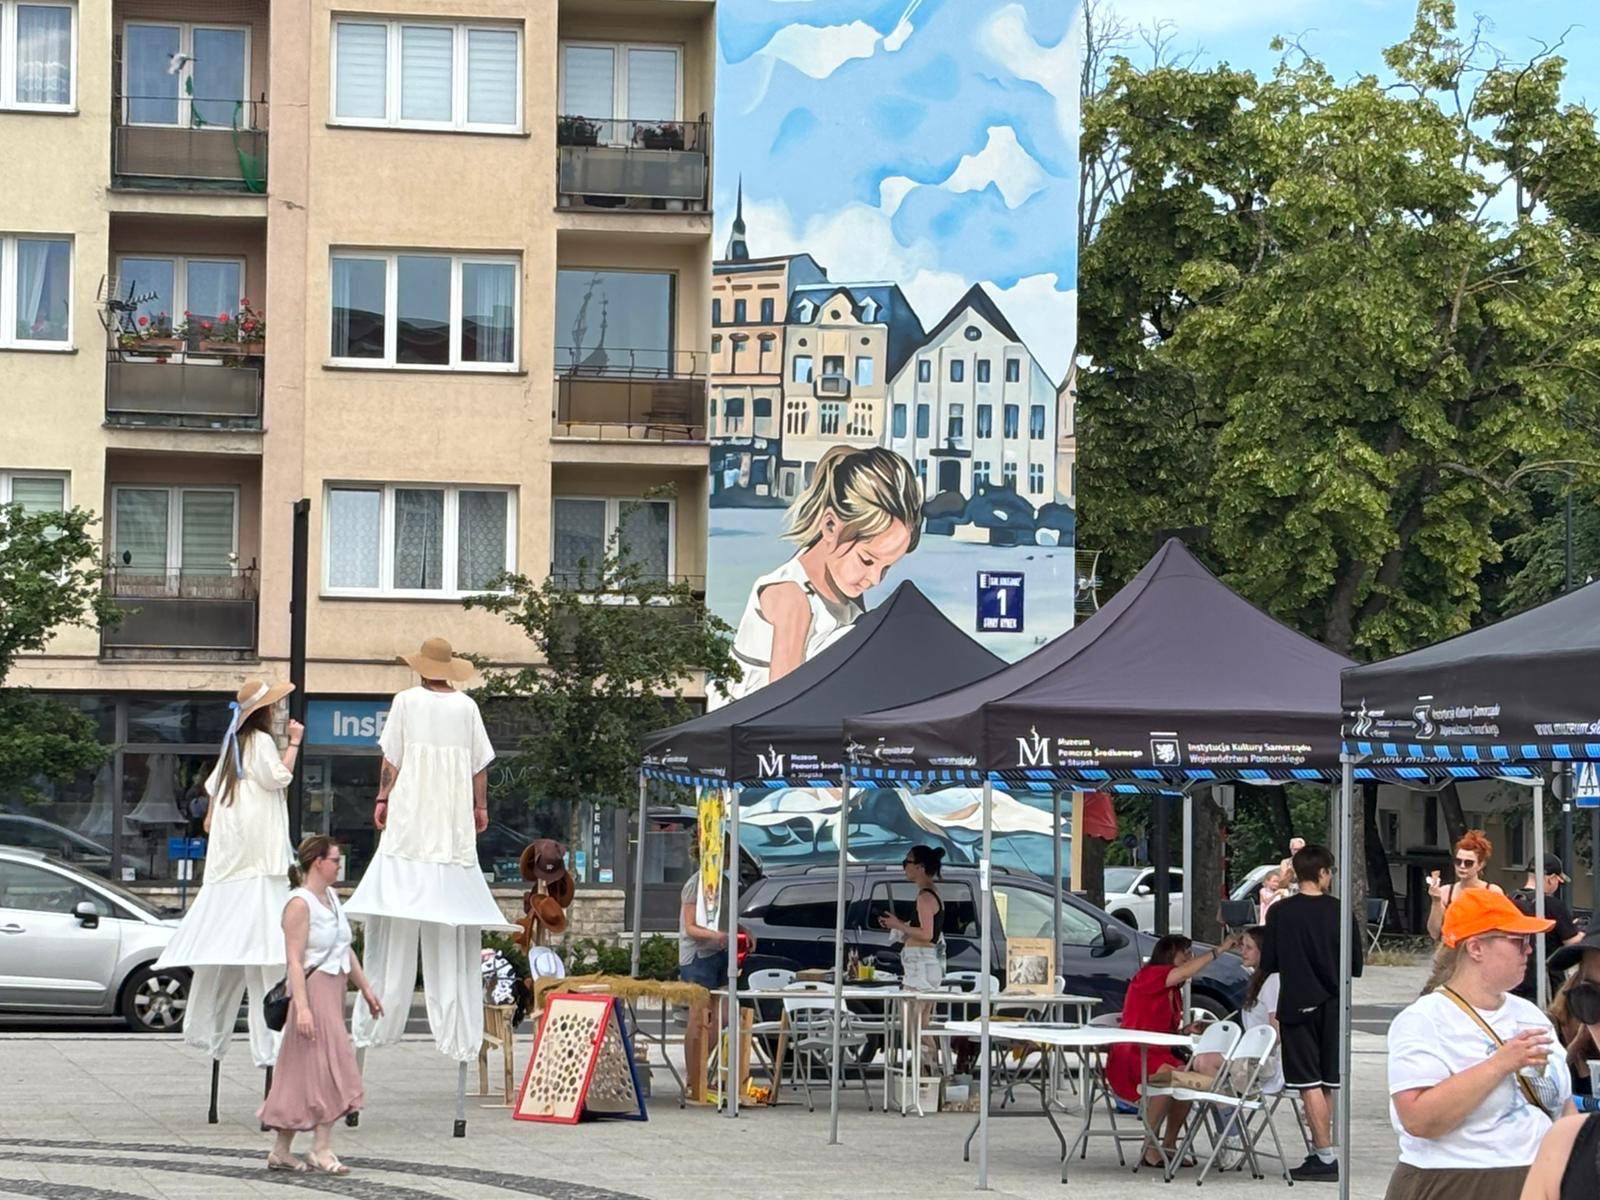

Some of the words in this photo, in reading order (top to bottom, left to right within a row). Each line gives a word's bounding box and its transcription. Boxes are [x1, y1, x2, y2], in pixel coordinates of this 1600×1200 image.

[997, 589, 1006, 616] 1
[1058, 738, 1090, 746] Muzeum
[1187, 742, 1230, 752] Instytucja
[1231, 743, 1262, 753] Kultury
[1058, 749, 1092, 757] Pomorza
[1250, 754, 1305, 765] Pomorskiego
